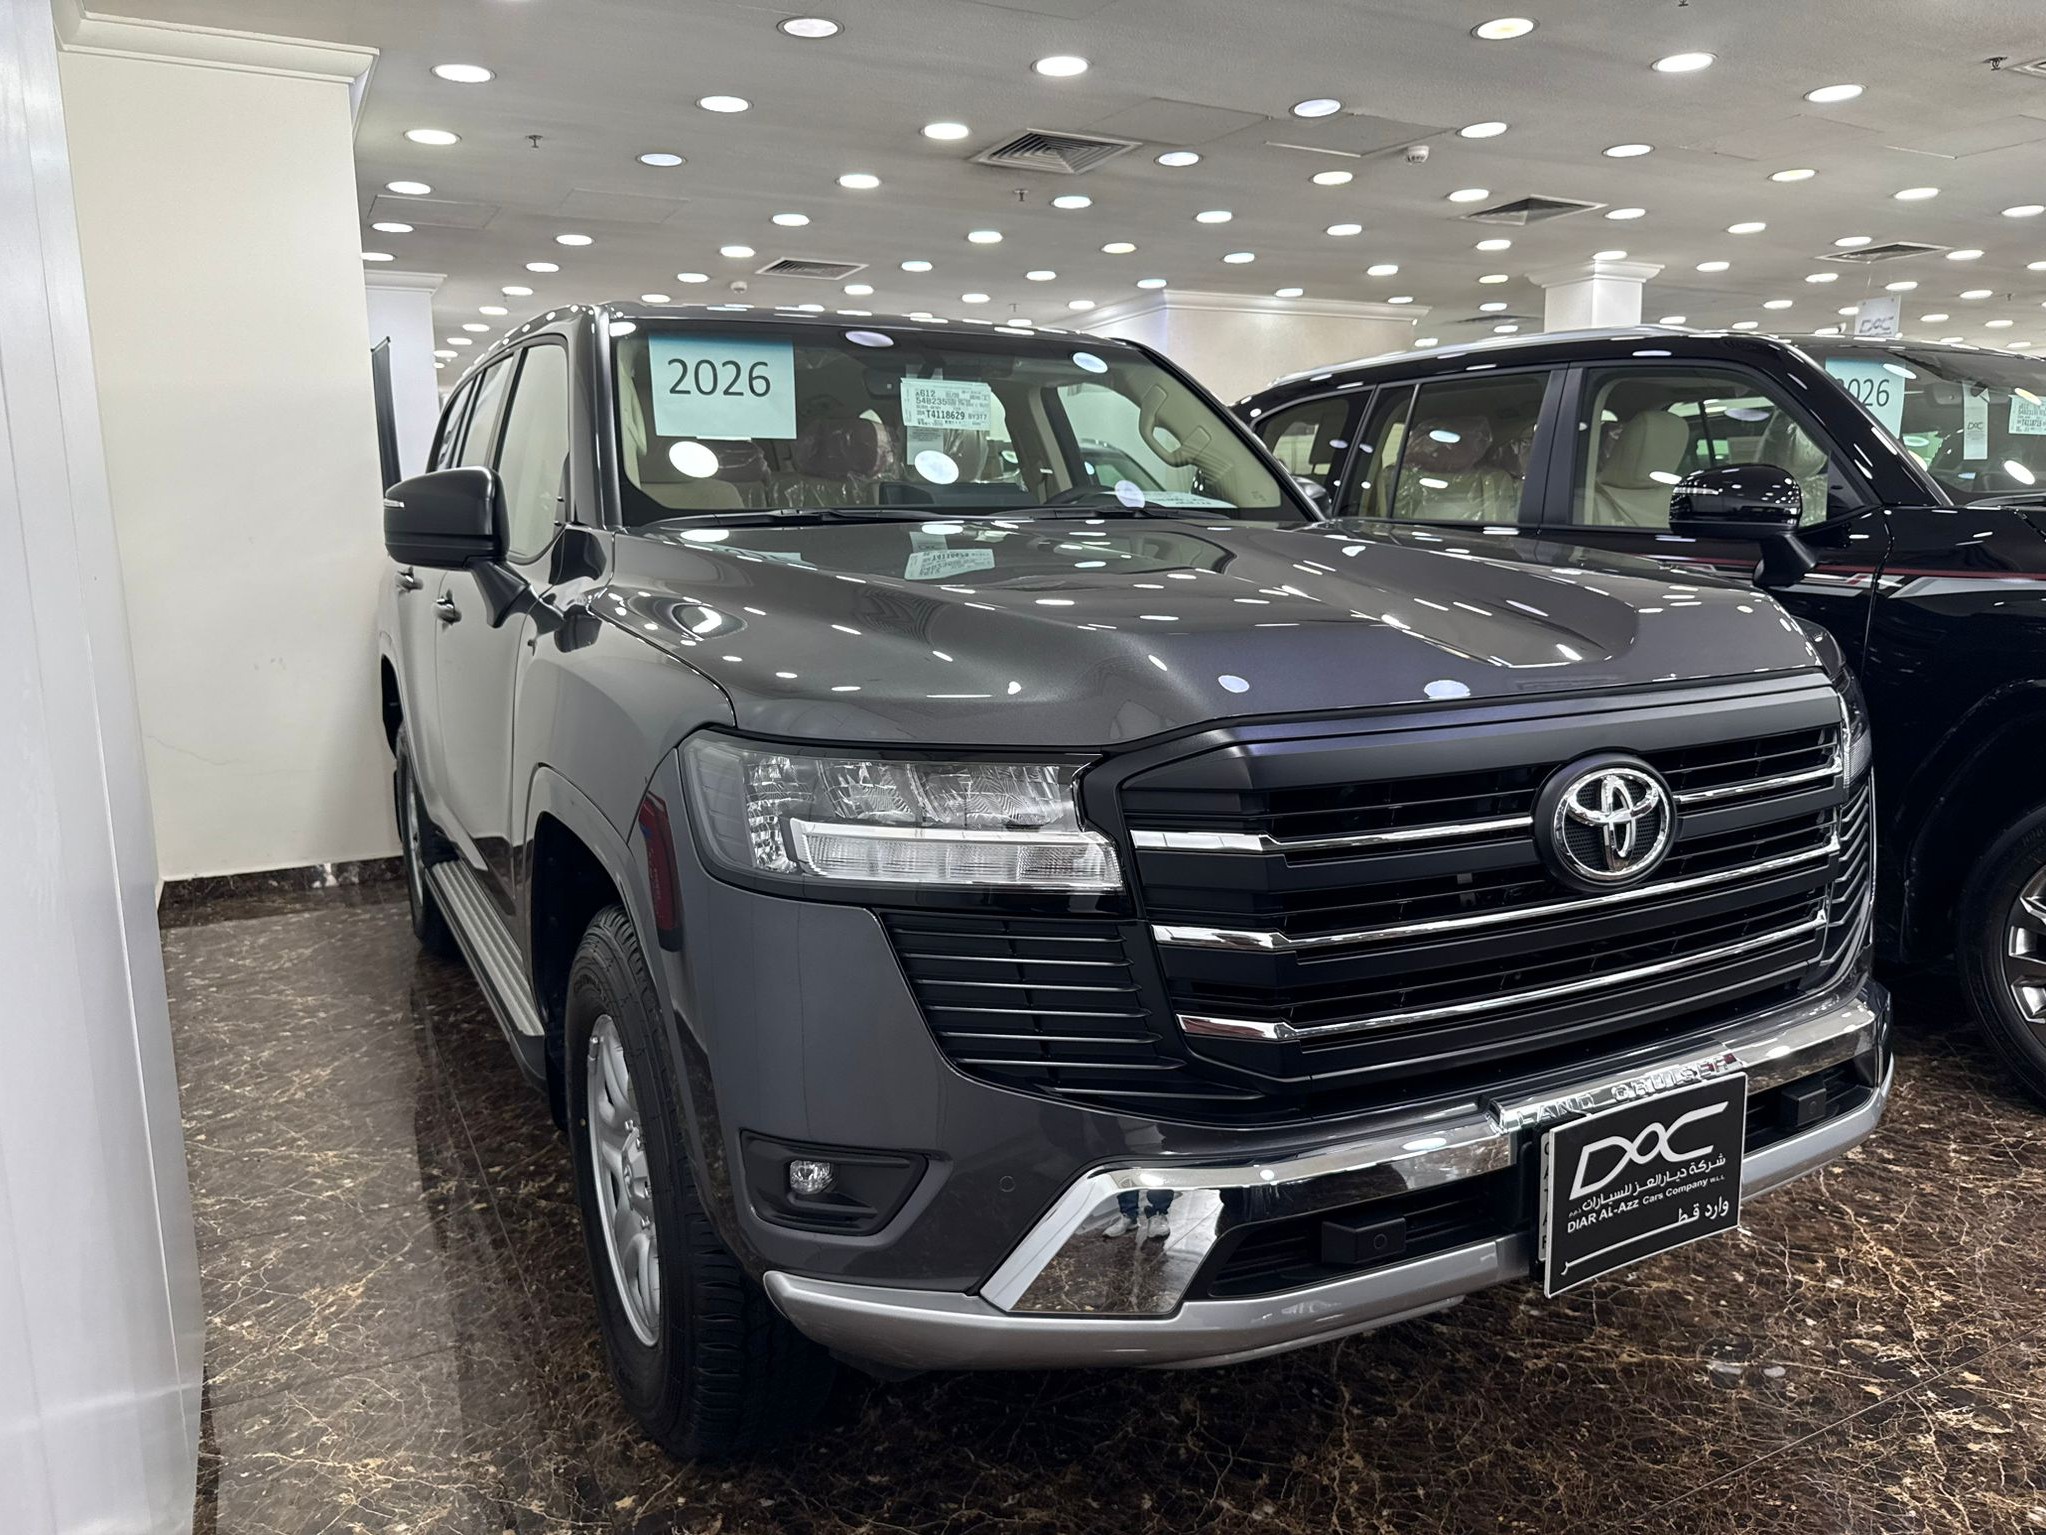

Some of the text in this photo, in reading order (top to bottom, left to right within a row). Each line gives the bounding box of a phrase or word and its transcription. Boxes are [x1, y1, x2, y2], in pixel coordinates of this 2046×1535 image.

[668, 358, 771, 397] 2026
[1518, 1053, 1738, 1124] LAND CRUISER
[1688, 1152, 1726, 1175] شركة
[1567, 1212, 1597, 1234] DIAR
[1599, 1199, 1639, 1221] AL-Azz
[1642, 1192, 1664, 1205] Cars
[1665, 1178, 1709, 1197] Company
[1582, 1183, 1633, 1211] للسيارات
[1704, 1195, 1729, 1220] وارد
